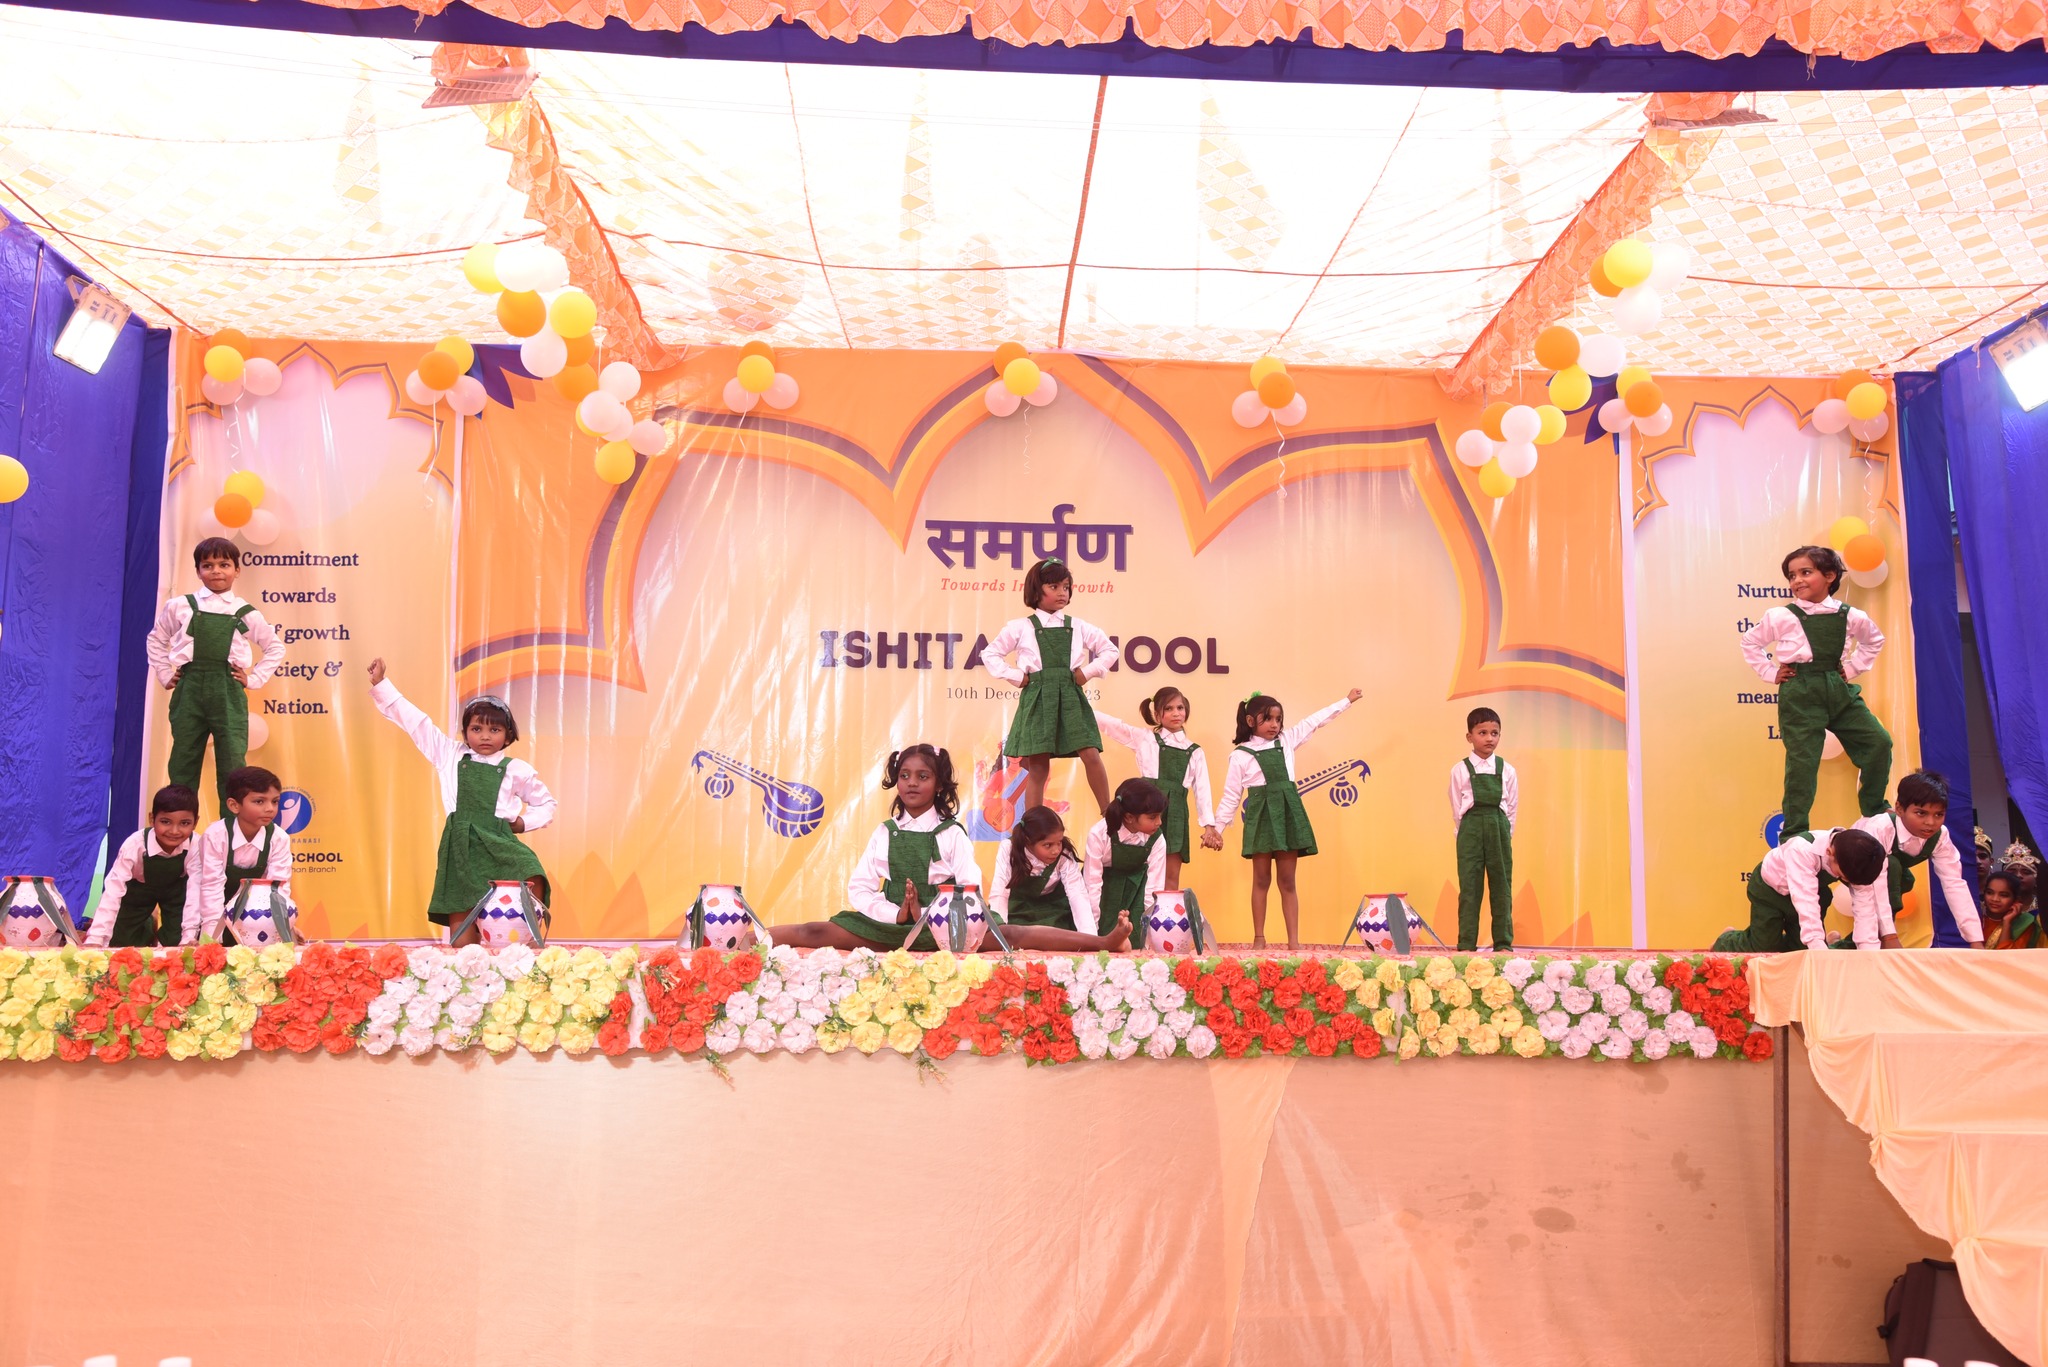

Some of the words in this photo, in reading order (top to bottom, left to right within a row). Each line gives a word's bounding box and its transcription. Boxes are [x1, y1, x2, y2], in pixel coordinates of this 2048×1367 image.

[925, 504, 1134, 573] समर्पण
[241, 550, 359, 567] Commitment
[940, 578, 1006, 592] Towards
[1071, 581, 1114, 594] rowth
[261, 587, 337, 603] towards
[284, 624, 350, 644] growth
[820, 630, 990, 670] ISHITA
[1089, 635, 1230, 674] OOL
[255, 661, 319, 681] ciety
[323, 661, 343, 677] &
[946, 687, 978, 699] 10th
[985, 687, 1020, 700] Dece
[1084, 689, 1101, 700] 23
[263, 698, 329, 715] Nation.
